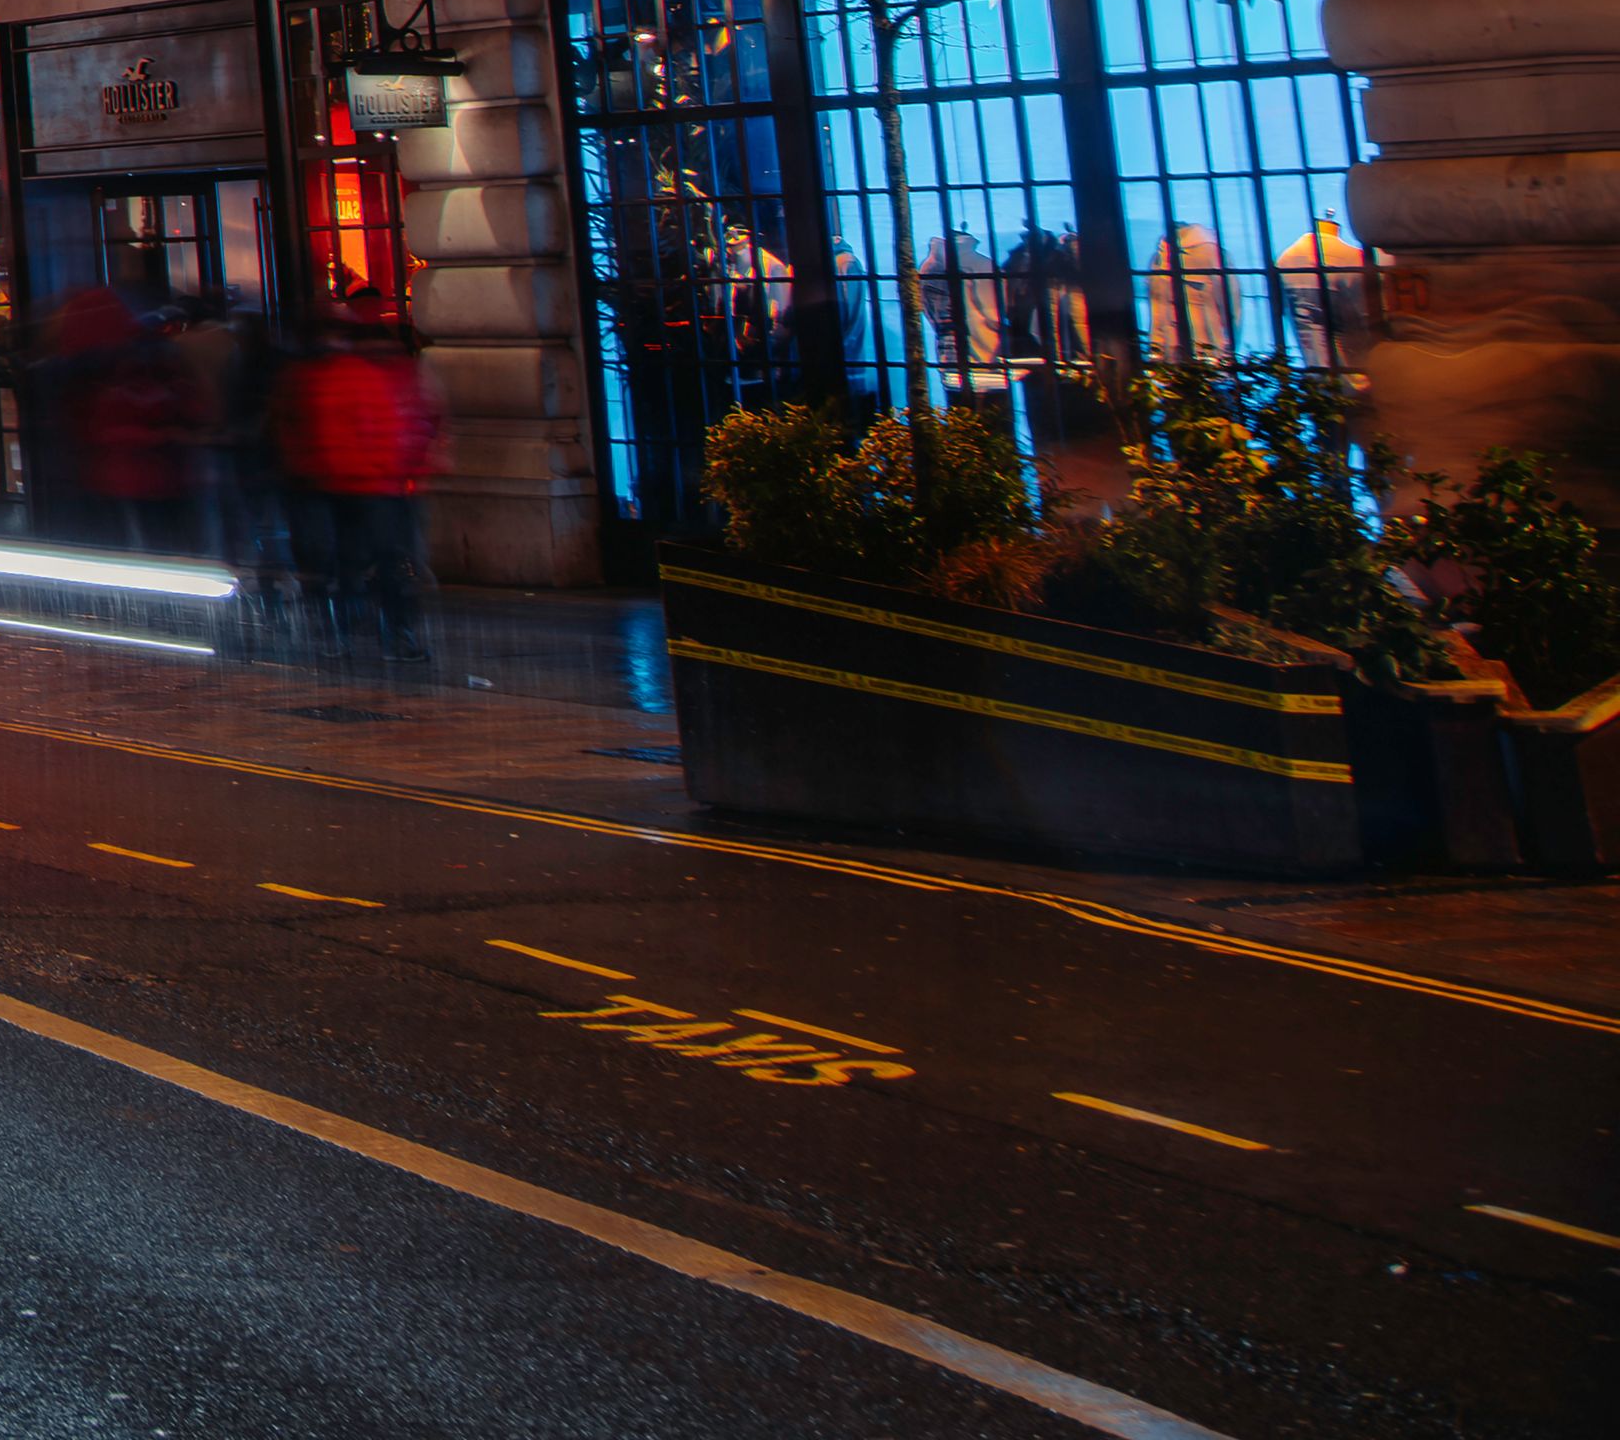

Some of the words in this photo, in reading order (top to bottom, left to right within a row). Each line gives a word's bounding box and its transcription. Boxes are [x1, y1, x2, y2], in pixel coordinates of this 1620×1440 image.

[102, 79, 179, 115] HOLLISTER
[354, 92, 441, 117] HOLLISTER
[537, 992, 917, 1087] TAXIS
